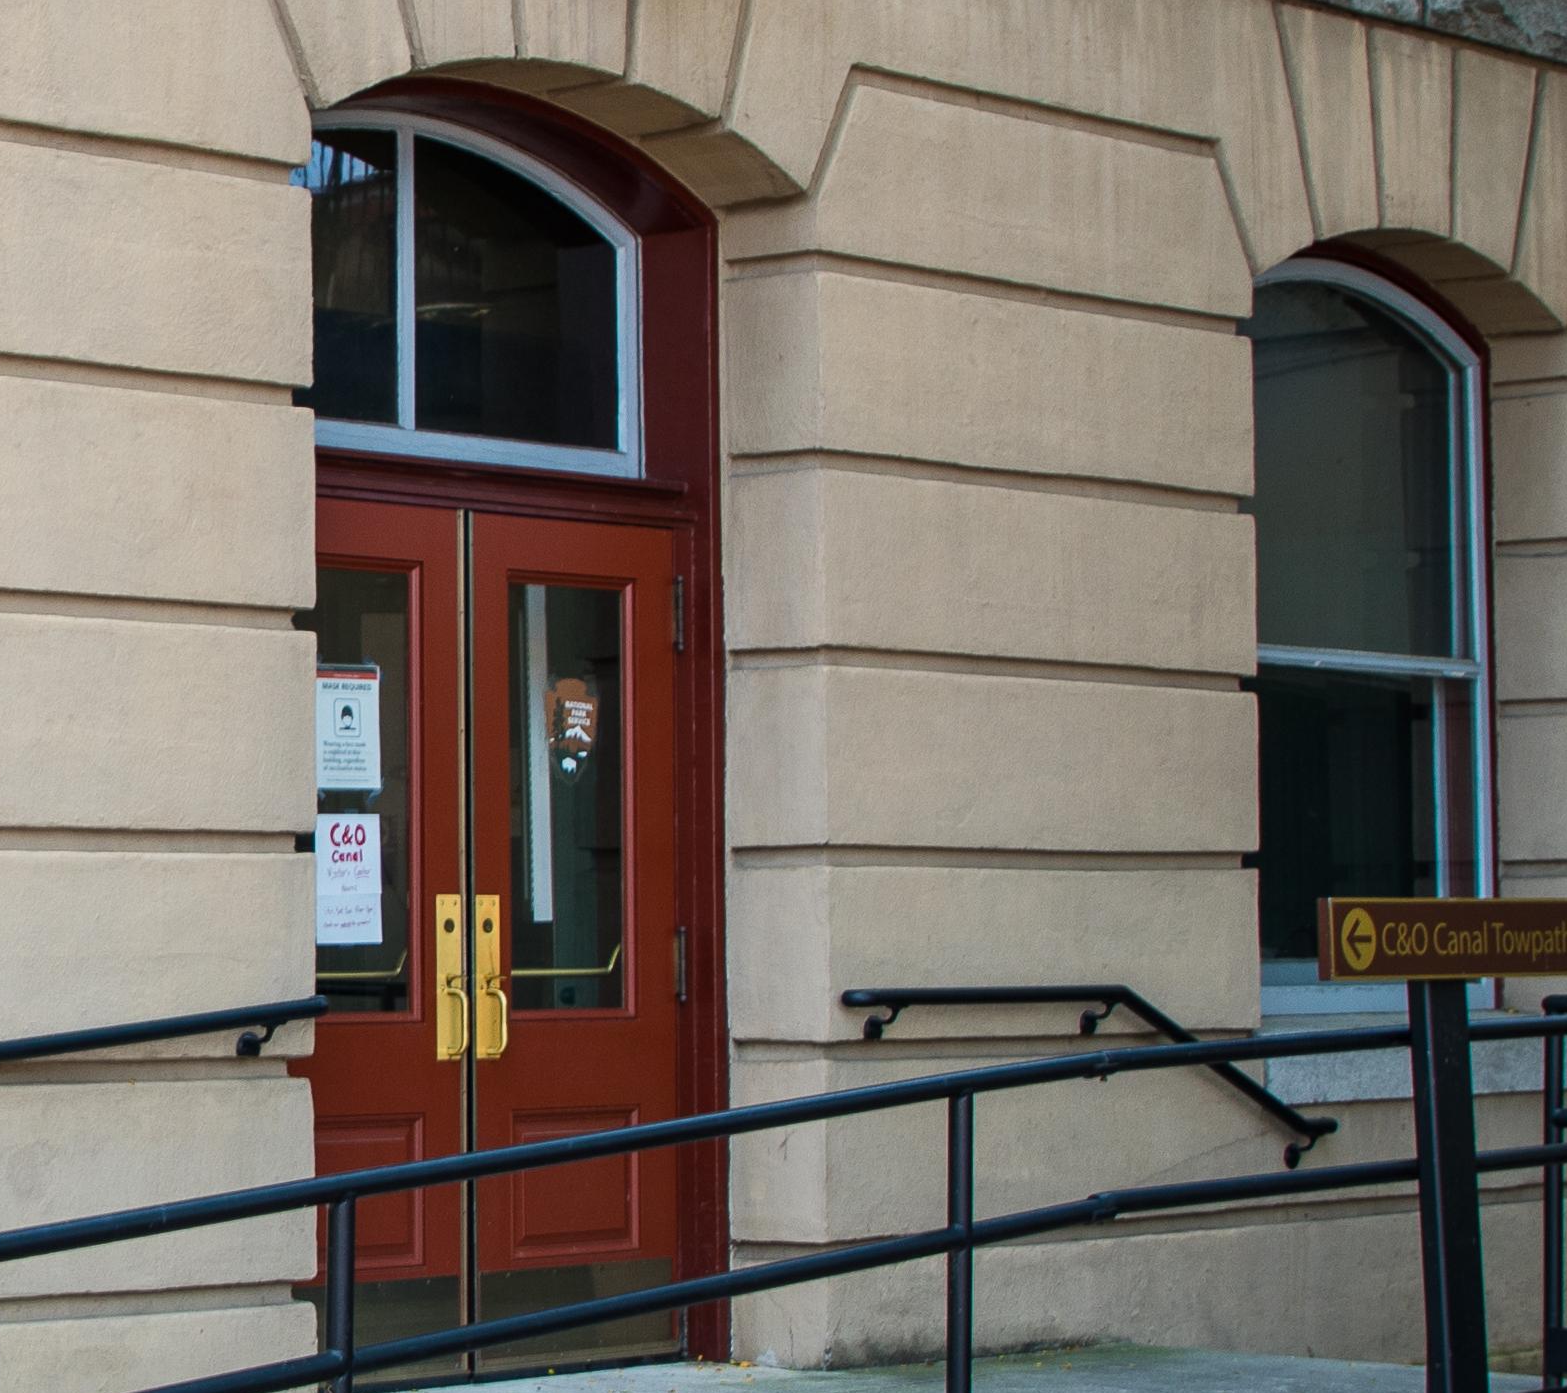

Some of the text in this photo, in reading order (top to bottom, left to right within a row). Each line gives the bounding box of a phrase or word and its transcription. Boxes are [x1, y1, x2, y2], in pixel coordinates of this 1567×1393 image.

[330, 822, 366, 847] C&O
[331, 849, 363, 863] Canal
[1382, 922, 1428, 956] C&O
[1433, 921, 1488, 955] Canal
